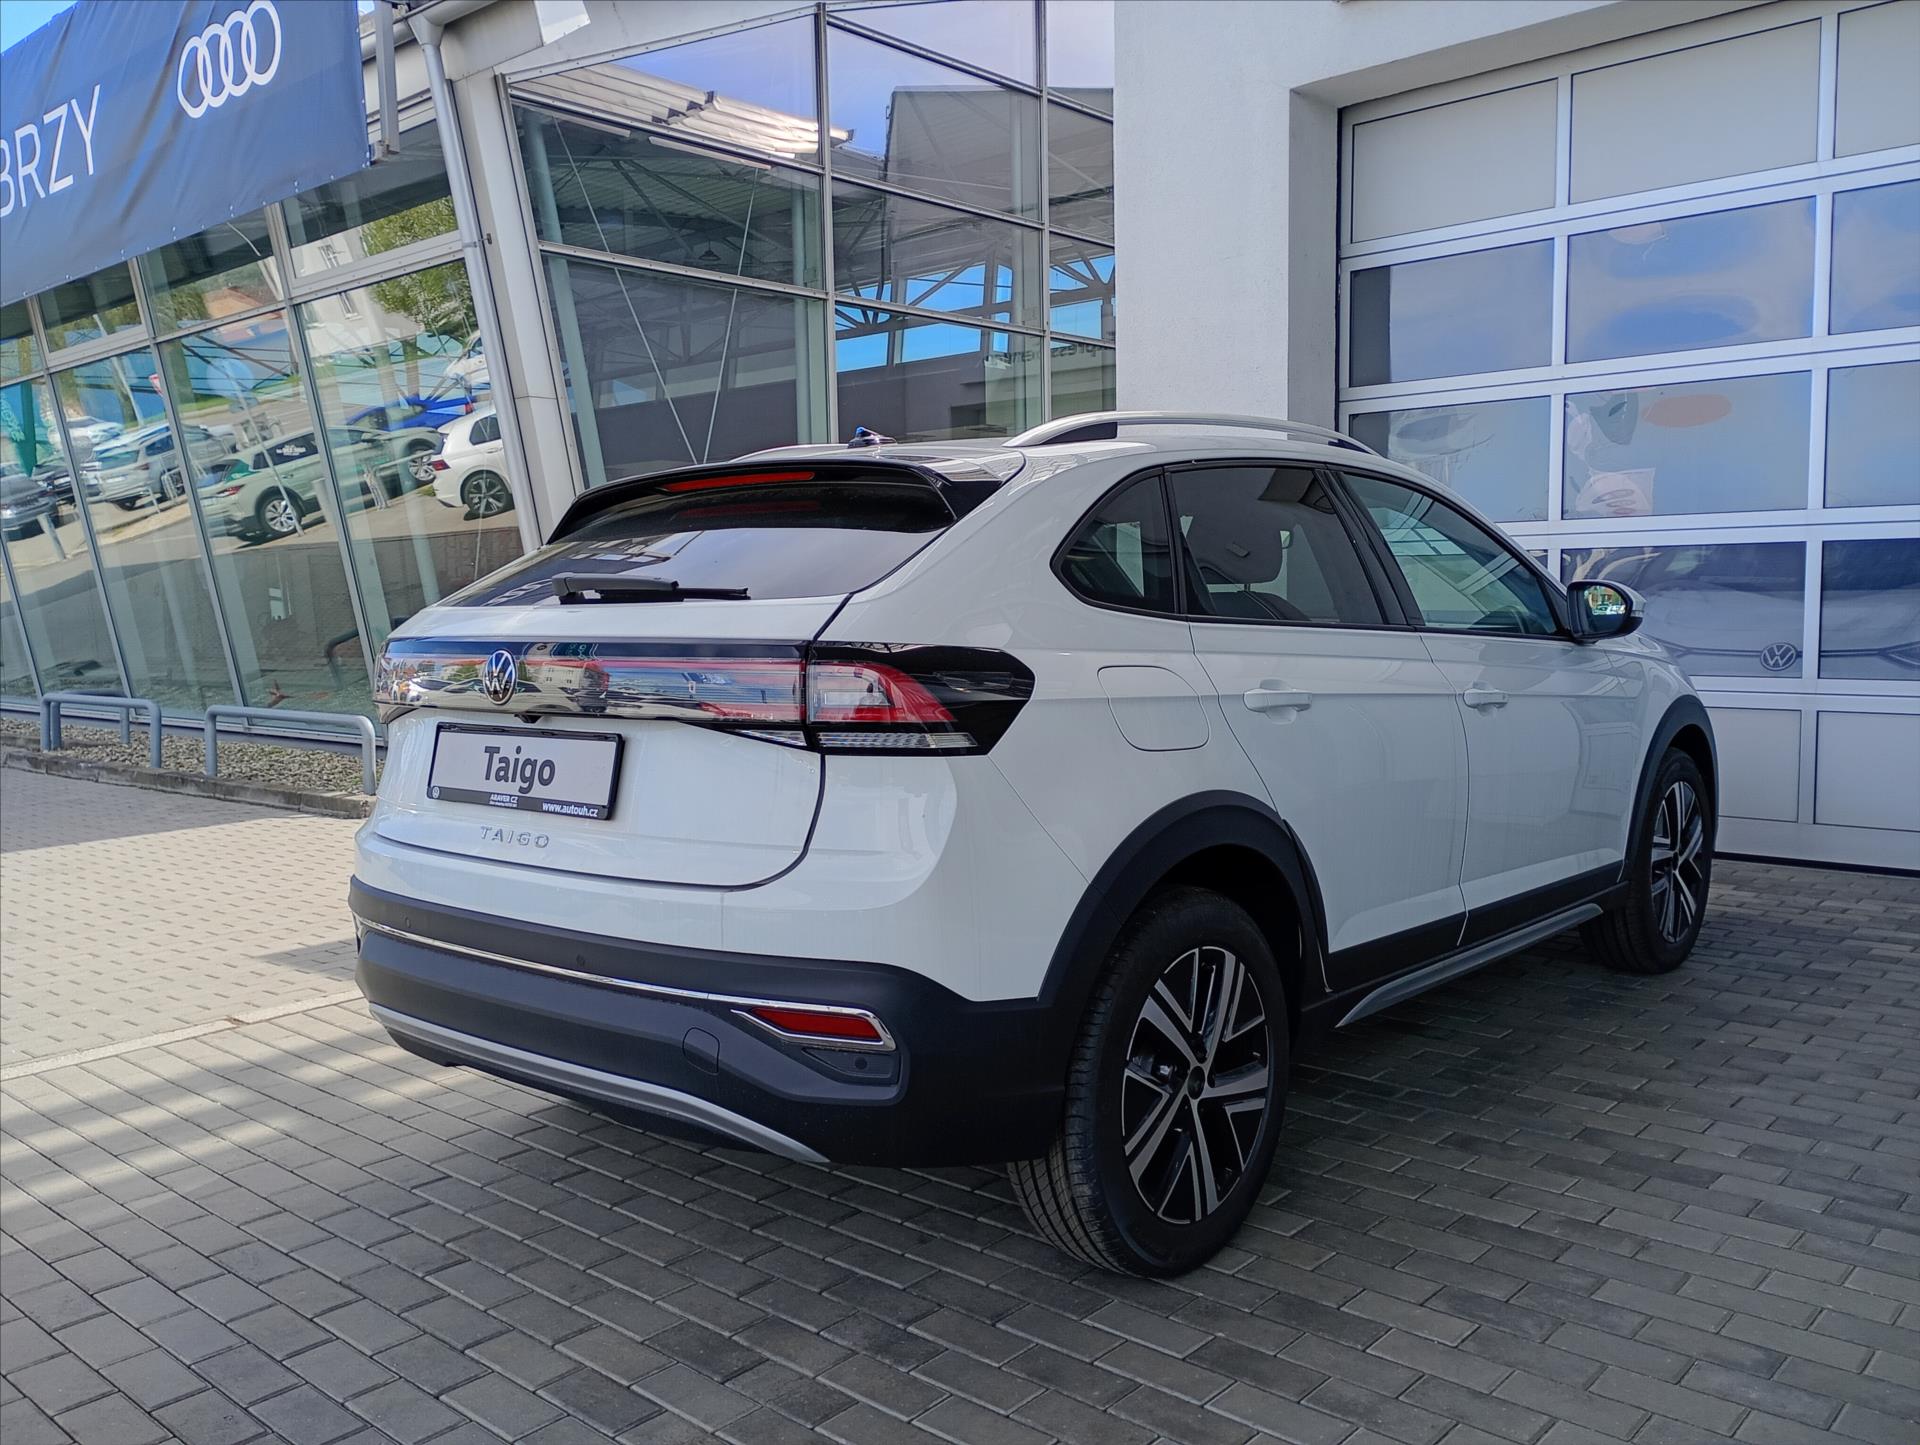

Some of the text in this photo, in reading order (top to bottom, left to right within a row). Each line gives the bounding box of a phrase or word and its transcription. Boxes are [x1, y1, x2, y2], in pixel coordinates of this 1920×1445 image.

[484, 745, 556, 794] Taigo
[542, 801, 598, 818] www.autouh.cz
[480, 826, 550, 849] TAIGO
